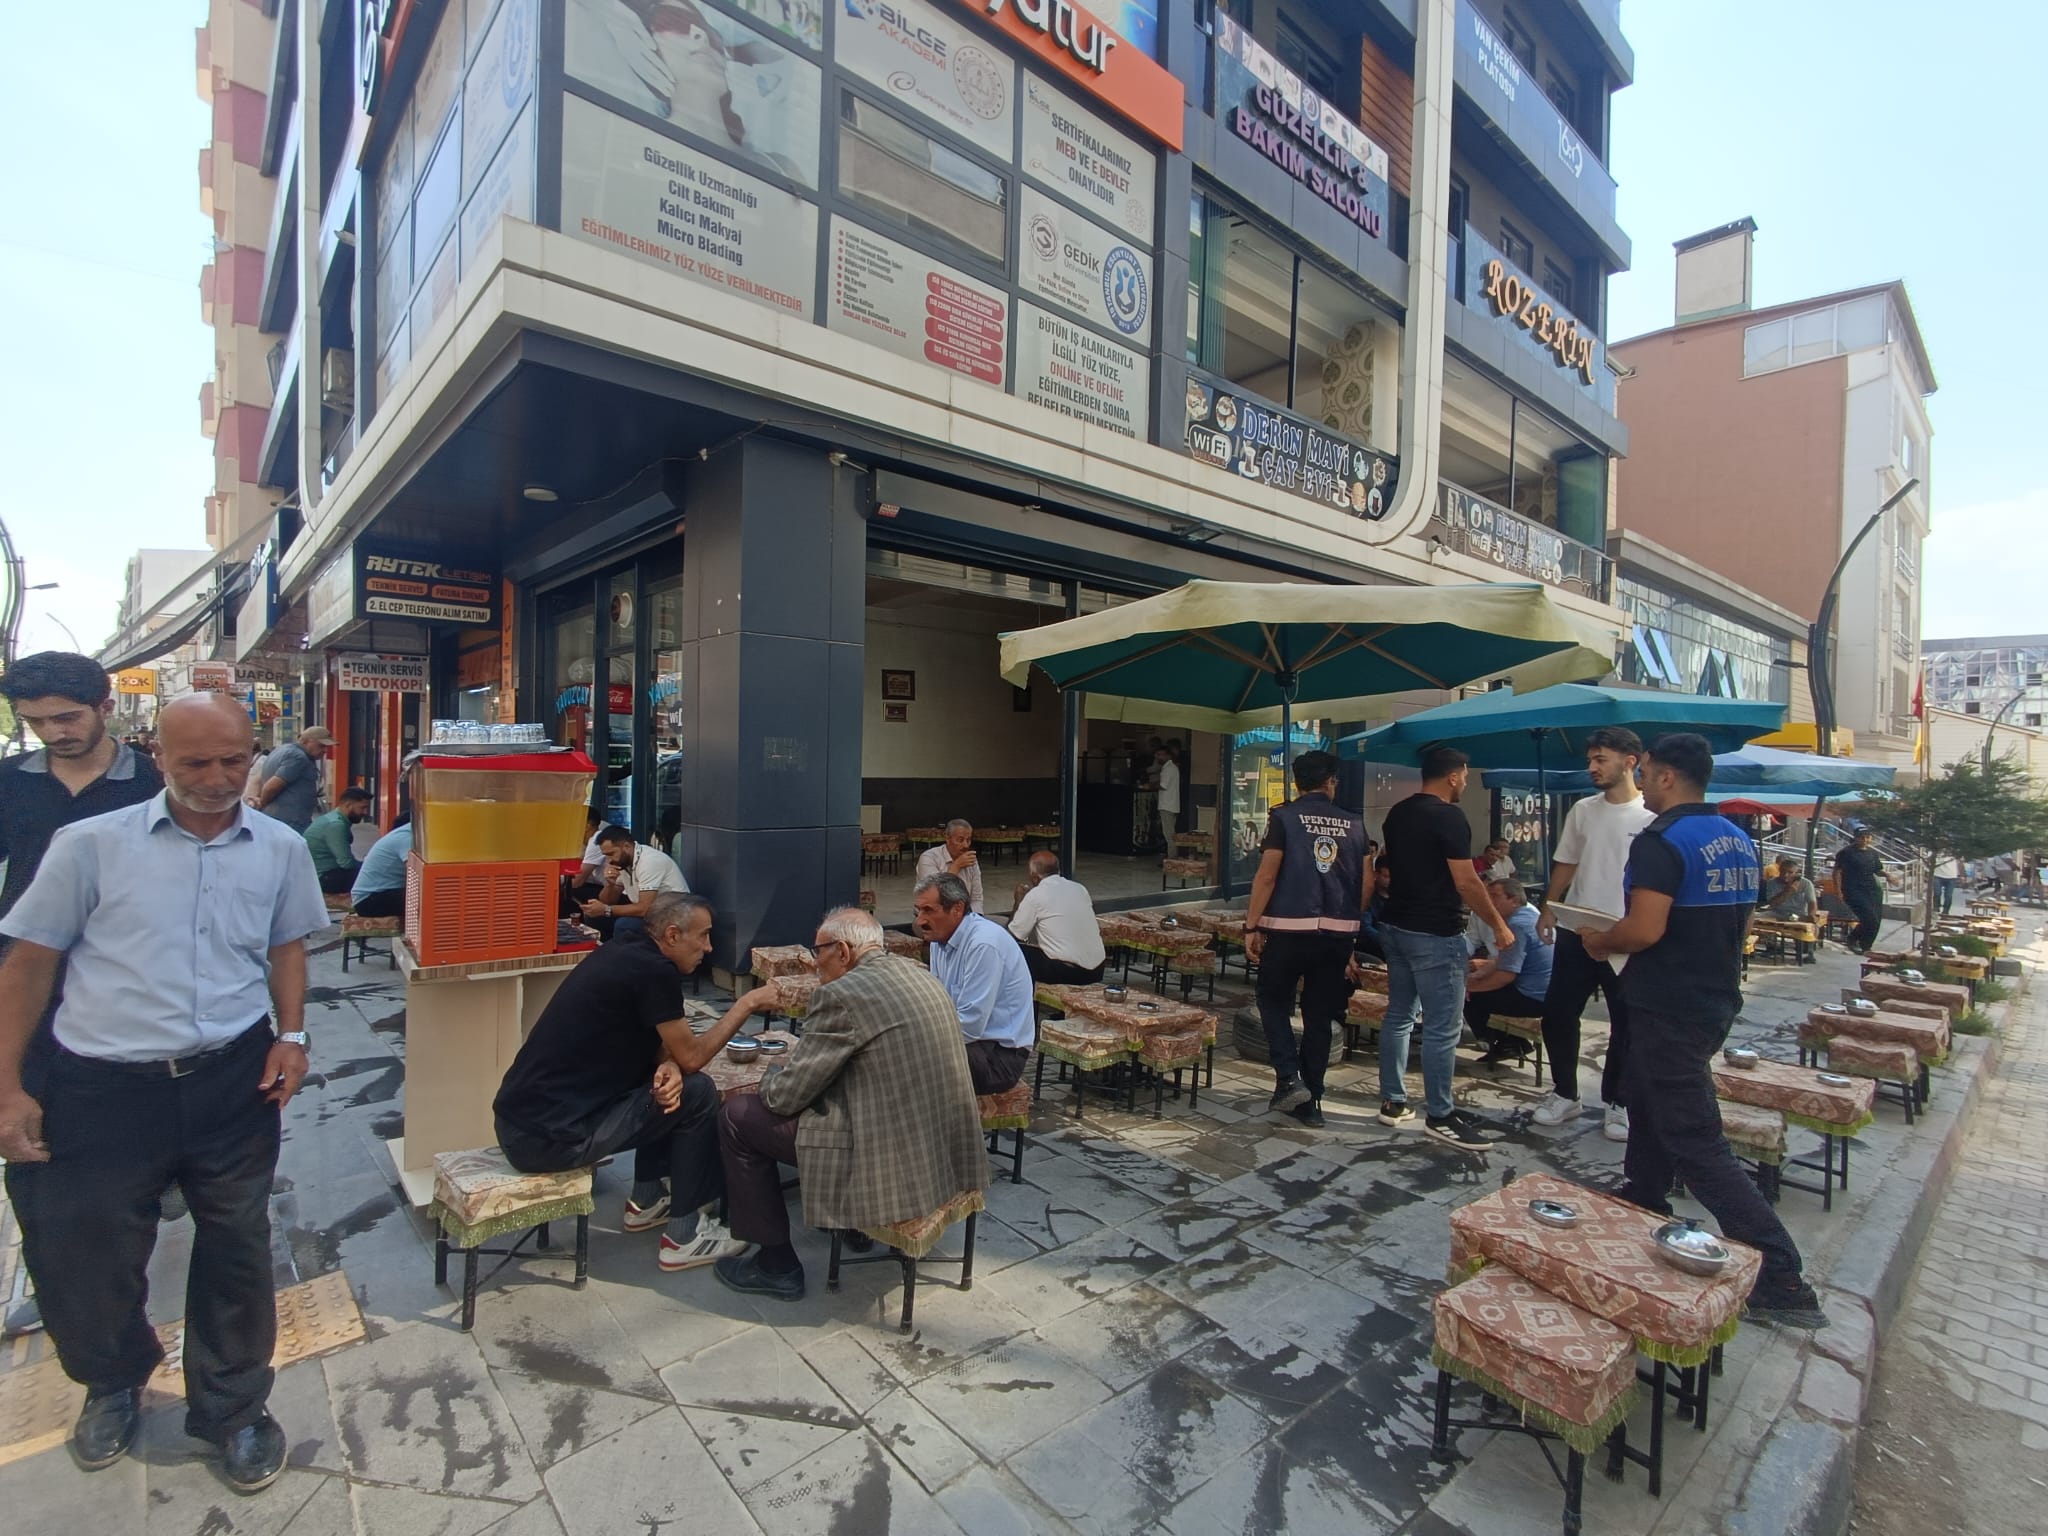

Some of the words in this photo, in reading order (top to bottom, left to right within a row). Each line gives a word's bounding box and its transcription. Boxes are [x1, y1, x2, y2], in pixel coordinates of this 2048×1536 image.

[878, 22, 946, 71] AKADEMİ
[880, 3, 947, 57] BİLGE
[985, 0, 1117, 73] atur
[1474, 17, 1492, 50] VAN
[1493, 43, 1520, 86] ÇEKİM
[1478, 47, 1515, 102] PLATOSU
[1051, 112, 1131, 175] SERTİFİKALARIMIZ
[1256, 84, 1353, 178] GÜZELLİK
[1357, 164, 1369, 189] &
[644, 147, 695, 182] Güzellik
[699, 171, 757, 208] Uzmanlığı
[1056, 137, 1076, 161] MEB
[1079, 150, 1090, 170] VE
[1092, 158, 1098, 174] E
[1100, 164, 1130, 194] DEVLET
[1069, 166, 1114, 205] ONAYLIDIR
[1236, 108, 1305, 180] BAKIM
[1311, 167, 1381, 235] SALONU
[659, 197, 695, 224] Kalıcı
[699, 214, 742, 245] Makyaj
[668, 180, 690, 201] Cilt
[693, 190, 735, 220] Bakımı
[581, 217, 671, 262] EĞİTİMLERİMİZ
[673, 253, 695, 272] YÜZ
[697, 262, 724, 283] YÜZE
[726, 273, 802, 312] VERİLMEKTEDİR
[657, 219, 694, 246] Micro
[698, 235, 743, 266] Blading
[1064, 244, 1100, 273] GEDİK
[1039, 316, 1067, 340] BÜTÜN
[1070, 328, 1079, 346] İŞ
[1081, 336, 1133, 370] ALANLARIYLA
[1487, 260, 1597, 384] ROZERİN
[1050, 361, 1082, 386] ONLİNE
[1083, 374, 1094, 390] VE
[1096, 380, 1124, 402] OFLİNE
[1052, 339, 1076, 364] İLGİLİ
[1081, 354, 1096, 372] YÜZ
[1099, 361, 1121, 383] YÜZE,
[1039, 376, 1101, 412] EĞİTİMLERDEN
[1103, 401, 1129, 422] SONRA
[1193, 431, 1226, 457] WiFi
[1243, 407, 1303, 458] DERİN
[1307, 433, 1349, 476] MAVİ
[1261, 451, 1299, 488] ÇAY
[1303, 465, 1332, 501] EVİ
[370, 601, 377, 610] 2.
[380, 601, 387, 611] EL
[389, 602, 403, 613] CEP
[405, 603, 441, 616] TELEFONU
[442, 607, 460, 618] ALIM
[463, 609, 487, 621] SATIMI
[351, 662, 387, 675] TEKNİK
[390, 663, 423, 677] SERVİS
[352, 676, 423, 690] FOTOKOPİ
[1306, 825, 1347, 837] ZABITA
